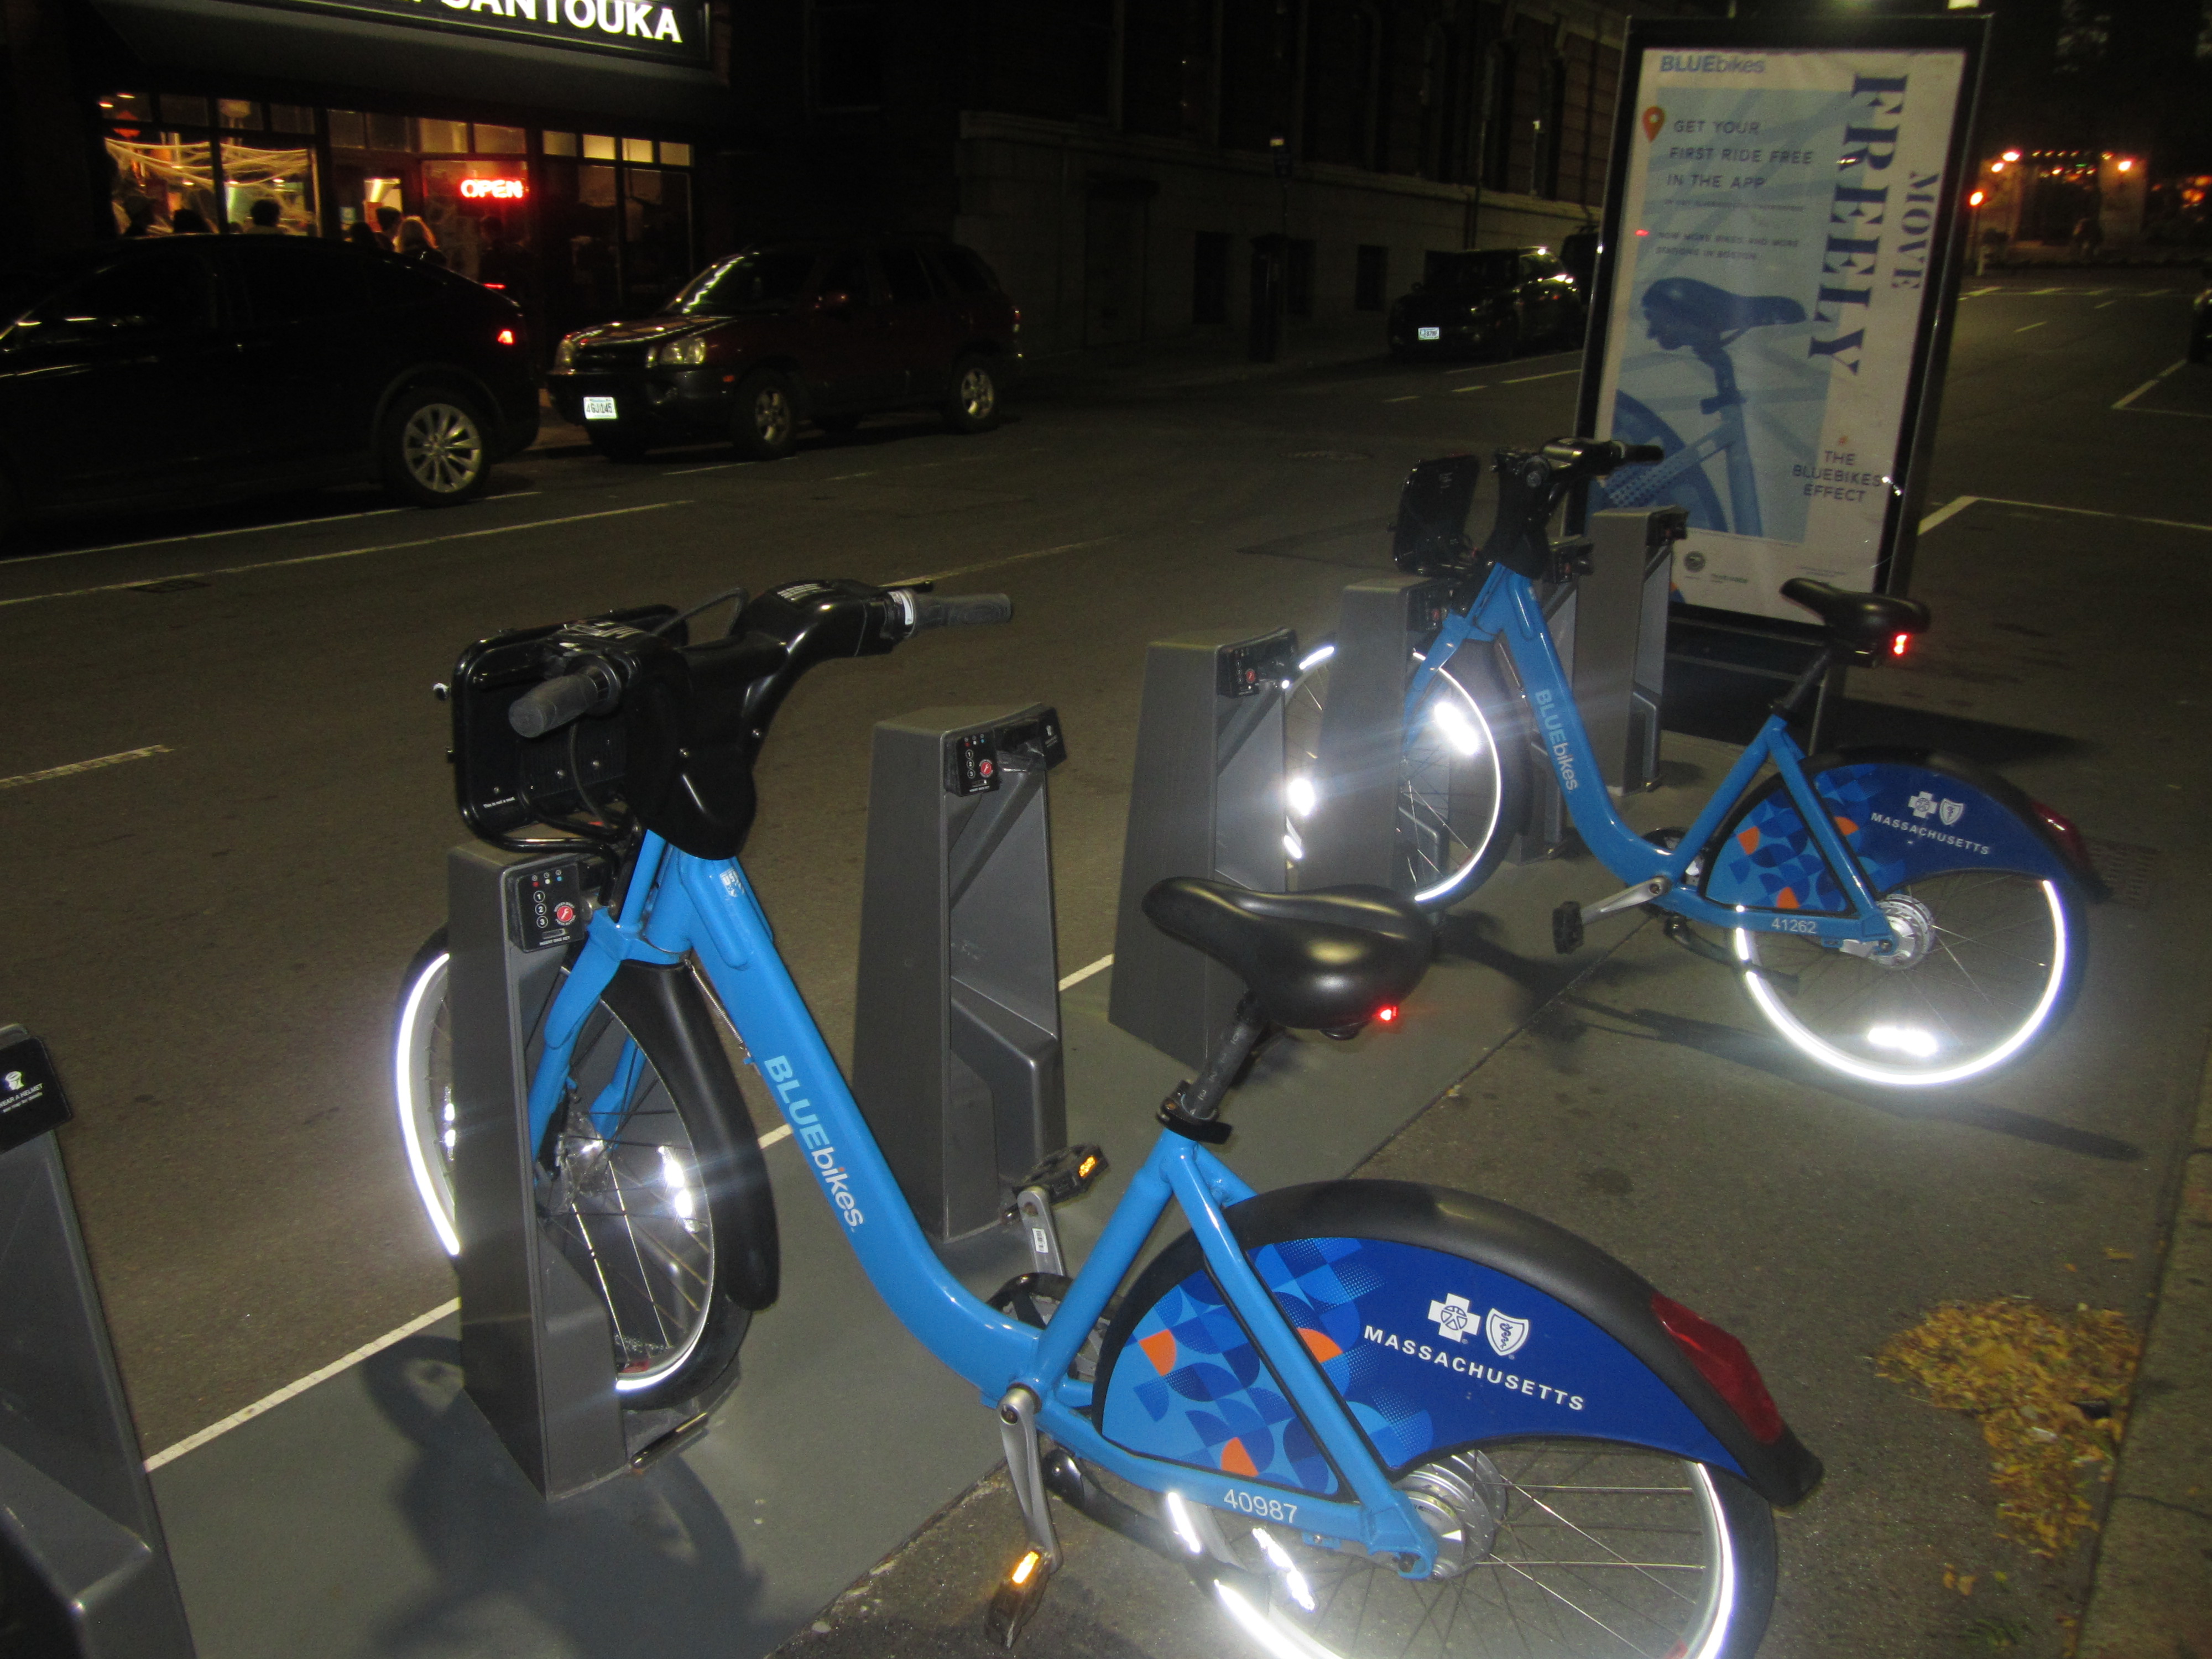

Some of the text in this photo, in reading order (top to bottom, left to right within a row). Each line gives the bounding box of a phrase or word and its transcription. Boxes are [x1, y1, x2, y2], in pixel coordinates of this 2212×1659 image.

[441, 0, 682, 43] NTOUKA
[1661, 55, 1766, 73] BLUEbikes
[1674, 120, 1761, 134] GET YOUR
[1669, 147, 1813, 164] FIRST RIDE FREE
[461, 179, 524, 198] OPEN
[1667, 174, 1767, 189] IN THE APP
[1808, 74, 1910, 375] FREELY
[1891, 171, 1939, 289] MOVE
[1825, 451, 1855, 465] THE
[1792, 465, 1881, 486] BLUEBIKES
[1804, 483, 1866, 502] EFFECT
[1535, 690, 1578, 791] BLUEbikes
[1871, 812, 1990, 855] MASSACHUSETTS
[1772, 917, 1817, 934] 41262
[764, 1055, 864, 1227] BLUEbikes
[1364, 1325, 1585, 1411] MASSACHUSETTS
[1224, 1489, 1297, 1524] 40987
